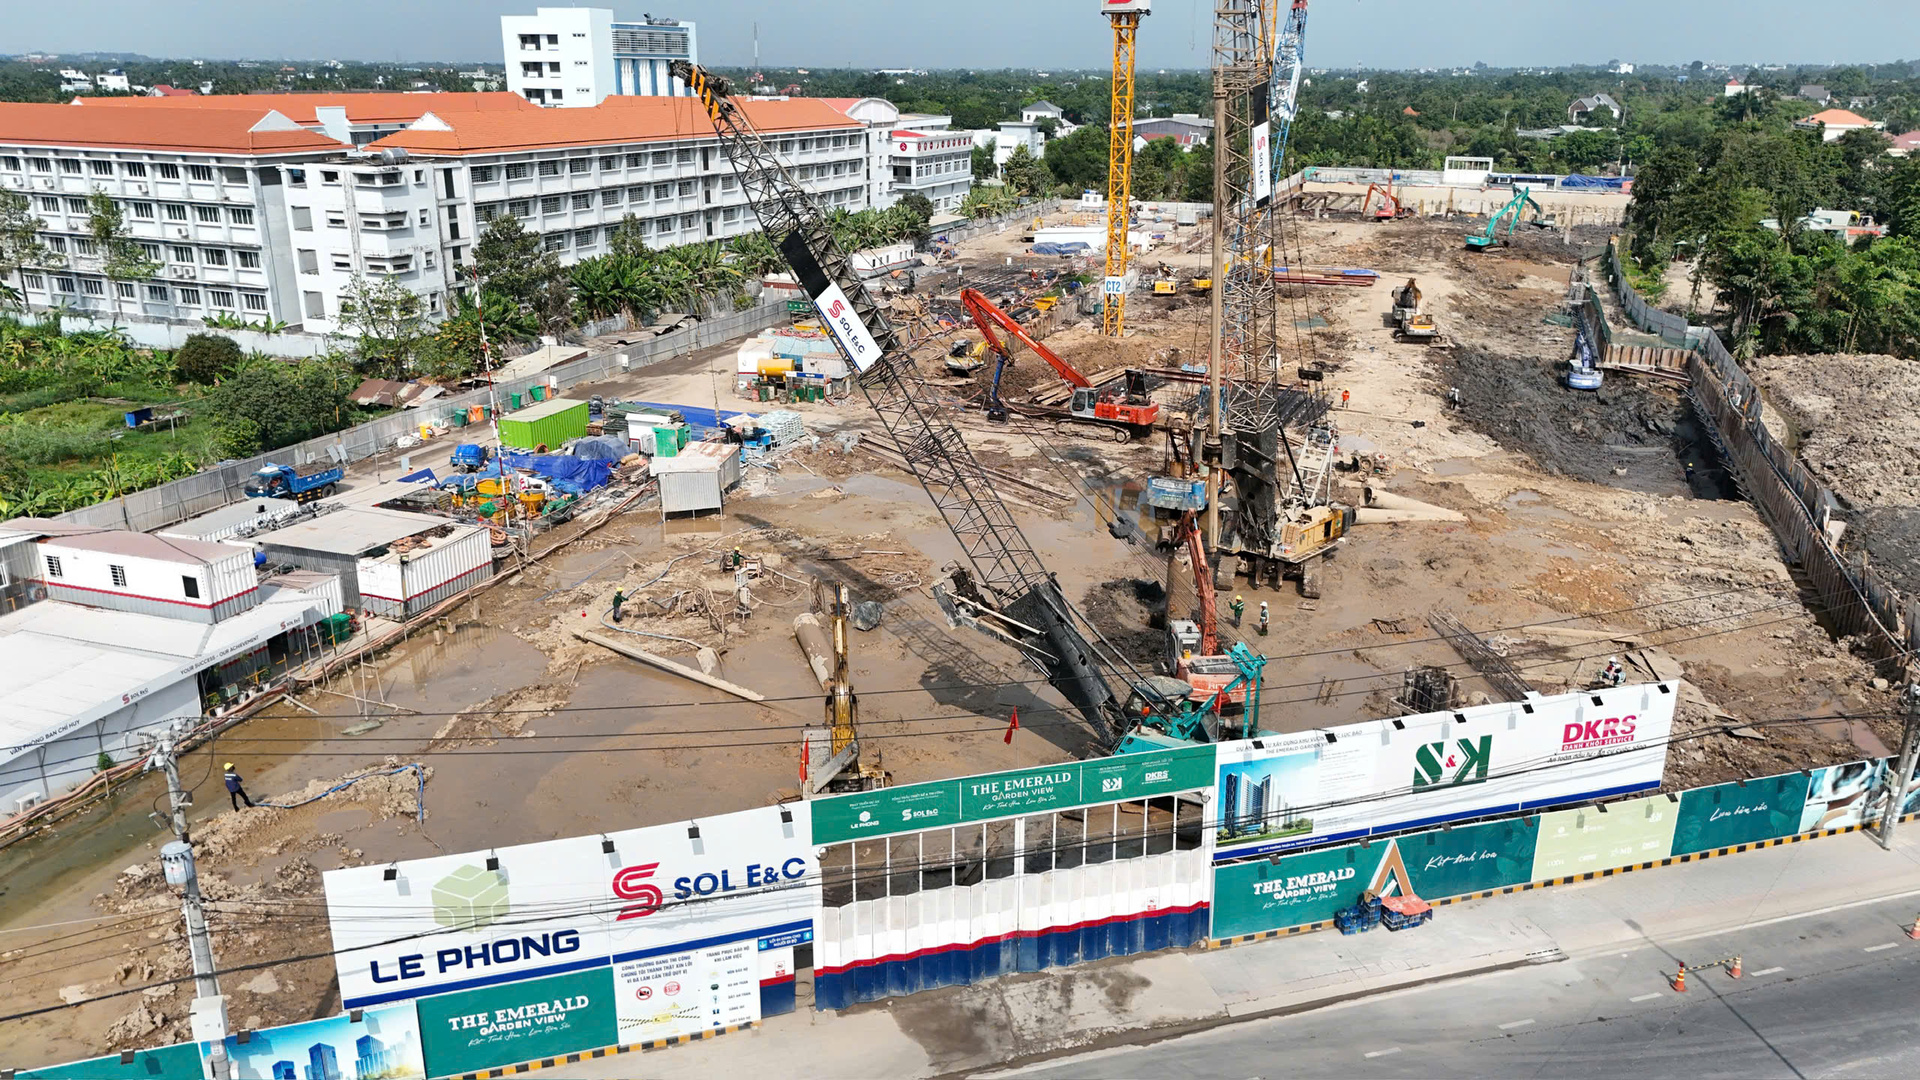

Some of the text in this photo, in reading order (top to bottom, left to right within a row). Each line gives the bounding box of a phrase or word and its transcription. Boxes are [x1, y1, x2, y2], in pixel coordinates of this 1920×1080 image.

[1106, 281, 1120, 292] CT2
[840, 318, 852, 336] SOL
[851, 336, 865, 353] E&C
[180, 665, 194, 675] YOUR
[195, 655, 215, 668] SUCCESS
[230, 635, 259, 651] ACHIEVEMENT
[45, 731, 57, 739] BAN
[69, 720, 80, 728] HUY
[1563, 715, 1636, 743] DKRS
[1564, 743, 1583, 751] DANH
[1604, 735, 1632, 745] SERVICE
[971, 773, 1071, 796] THE EMERALD
[1145, 770, 1168, 780] DKRS
[992, 786, 1054, 801] GARDEN VIEW
[674, 858, 806, 899] SOL E&C
[1253, 868, 1356, 895] THE EMERALD
[1273, 883, 1337, 900] GARDEN VIEW
[370, 929, 580, 984] LE PHONG
[448, 995, 589, 1031] THE EMERALD
[480, 1013, 566, 1036] GARDEN VIEW
